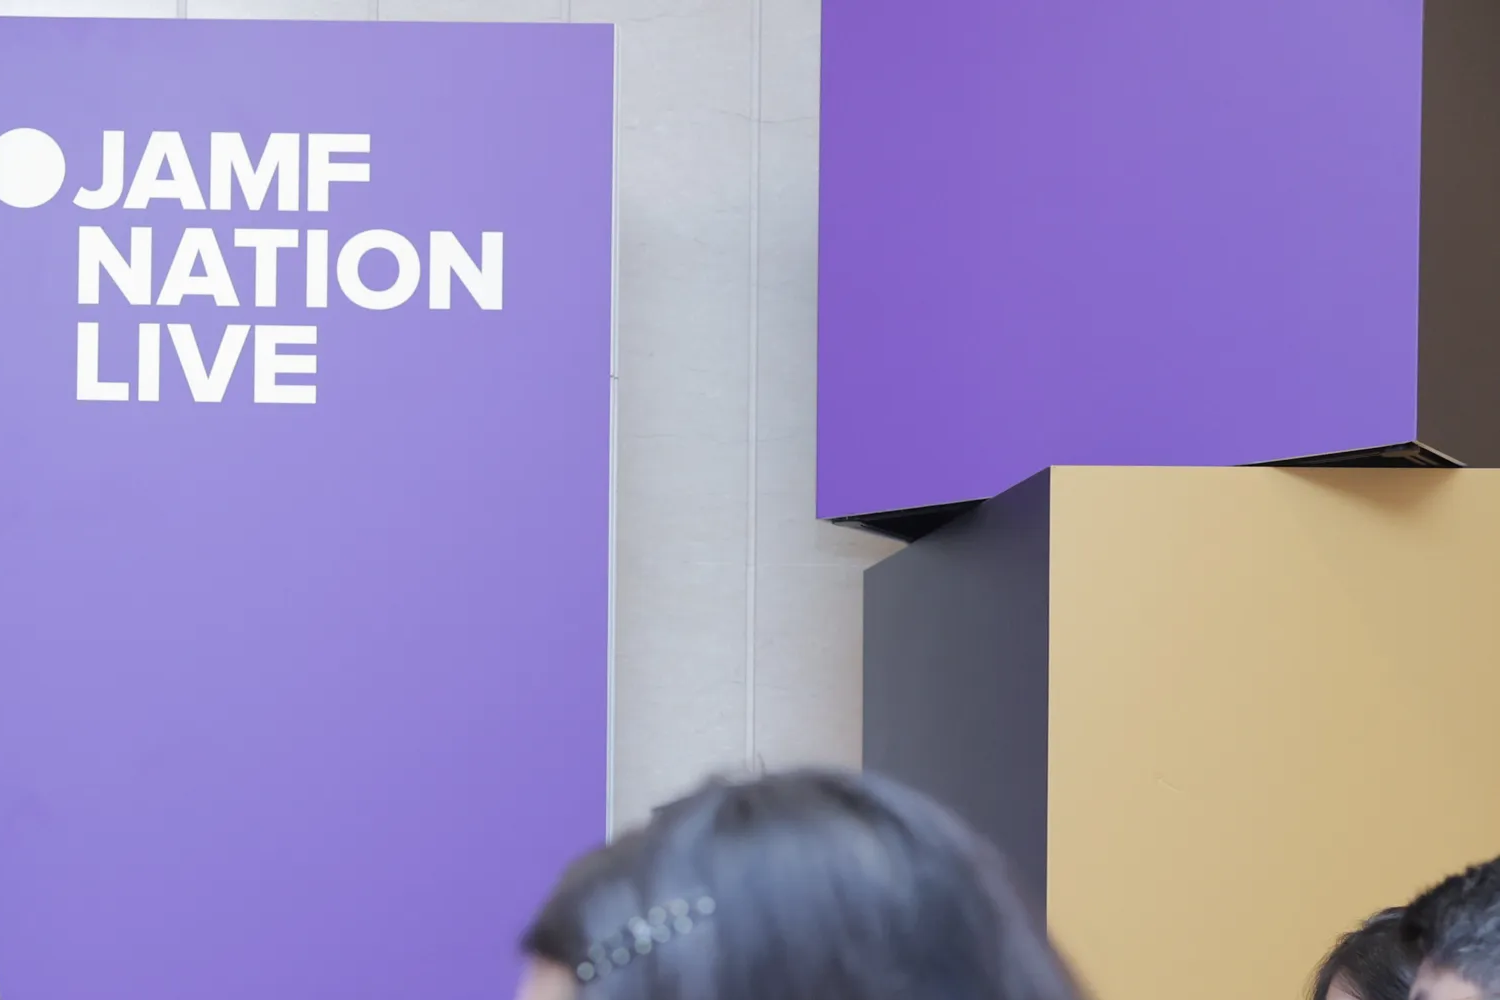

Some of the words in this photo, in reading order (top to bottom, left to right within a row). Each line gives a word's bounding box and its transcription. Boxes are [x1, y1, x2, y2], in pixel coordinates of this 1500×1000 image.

[72, 130, 371, 212] JAMF
[78, 226, 504, 311] NATION
[76, 322, 318, 404] LIVE
